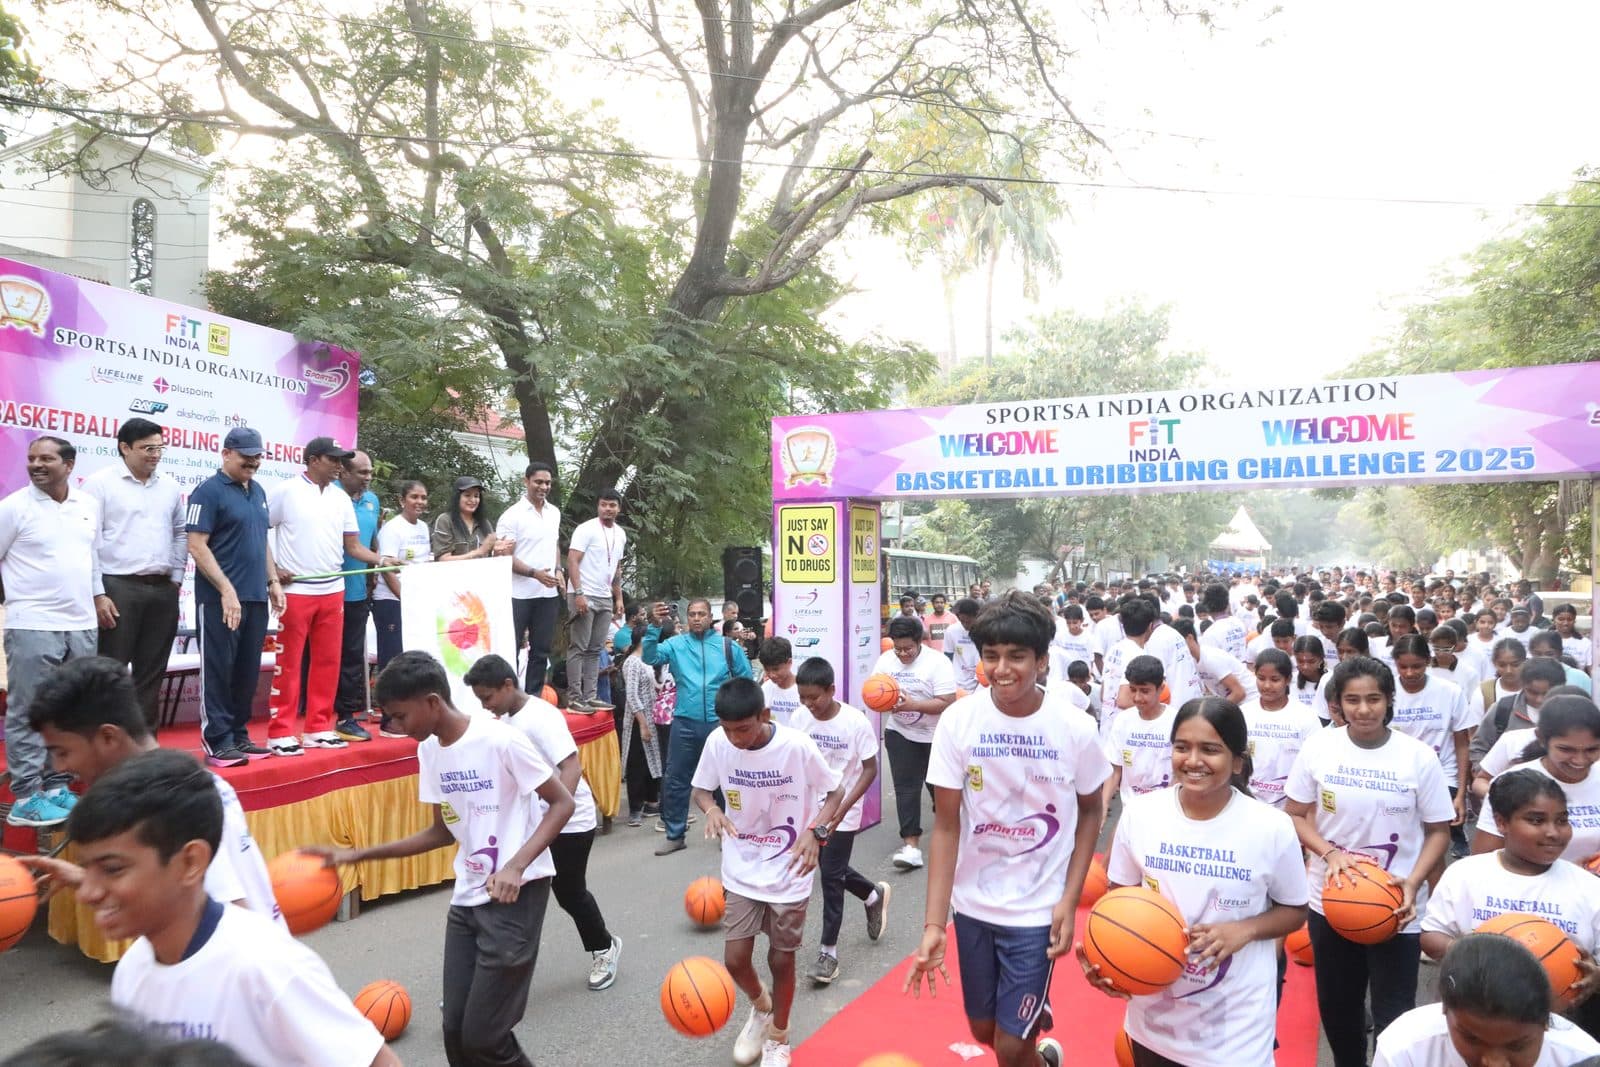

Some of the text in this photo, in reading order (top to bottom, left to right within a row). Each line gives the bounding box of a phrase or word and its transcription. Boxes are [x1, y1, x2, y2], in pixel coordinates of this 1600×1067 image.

[165, 335, 200, 351] INDIA
[55, 328, 307, 394] SPORTSA INDIA ORGANIZATION
[97, 367, 144, 382] LIFELINE
[171, 382, 213, 398] pluspoint
[986, 381, 1398, 425] SPORTSA INDIA ORGANIZATION
[176, 408, 220, 423] akshayam
[1262, 412, 1415, 447] WELCOME
[939, 428, 1059, 458] WELCOME
[1129, 447, 1181, 462] INDIA
[896, 447, 1535, 491] BASKETBALL DRIBBLING CHALLENGE 2025
[787, 519, 828, 531] JUST SAY
[786, 559, 830, 571] TO DRUGS
[980, 734, 1045, 746] BASKETBALL
[1011, 747, 1059, 760] CHALLENGE
[735, 768, 782, 780] BASKETBALL
[1338, 765, 1398, 781] BASKETBALL
[757, 776, 793, 788] CHALLENGE
[973, 823, 1035, 836] SPORTSA
[738, 833, 781, 844] SPORTSA
[1160, 842, 1236, 864] BASKETBALL
[1145, 856, 1252, 881] DRIBBLING CHALLENGE
[1486, 895, 1562, 915] BASKETBALL
[1018, 993, 1036, 1021] 8
